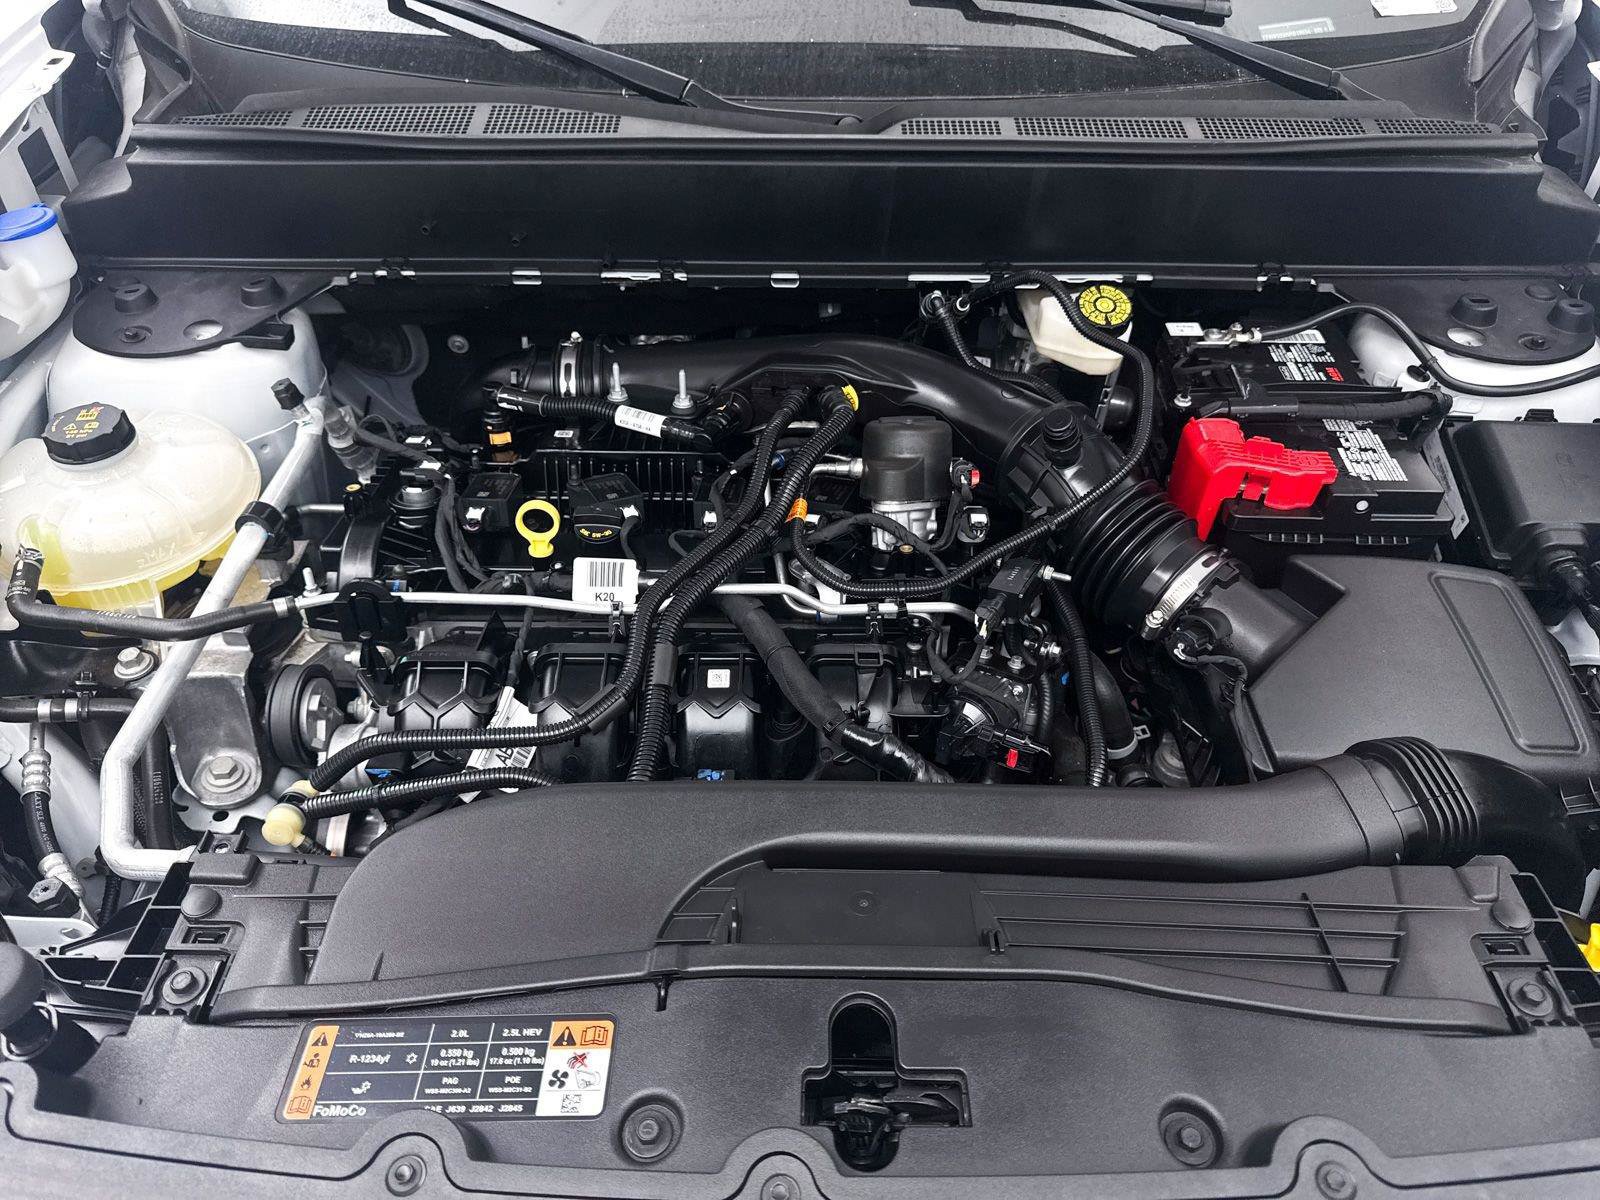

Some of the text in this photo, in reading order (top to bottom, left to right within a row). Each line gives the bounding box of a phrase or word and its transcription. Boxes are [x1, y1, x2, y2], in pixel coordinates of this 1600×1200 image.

[595, 592, 615, 602] K20
[450, 1029, 470, 1038] 2.0L
[502, 1028, 543, 1037] 2.5L HEV
[440, 1048, 474, 1059] 0.550 kg
[524, 1046, 536, 1057] kg
[348, 1054, 391, 1065] R-1234yf
[430, 1059, 439, 1067] 19
[449, 1058, 465, 1067] (1.21
[466, 1058, 480, 1067] lbs)
[531, 1056, 545, 1065] lbs)
[442, 1077, 459, 1085] PAG
[505, 1076, 522, 1084] POE
[312, 1103, 367, 1117] FoMoCo
[445, 1105, 466, 1113] J639
[468, 1104, 494, 1113] J2842
[497, 1104, 523, 1112] J2845
